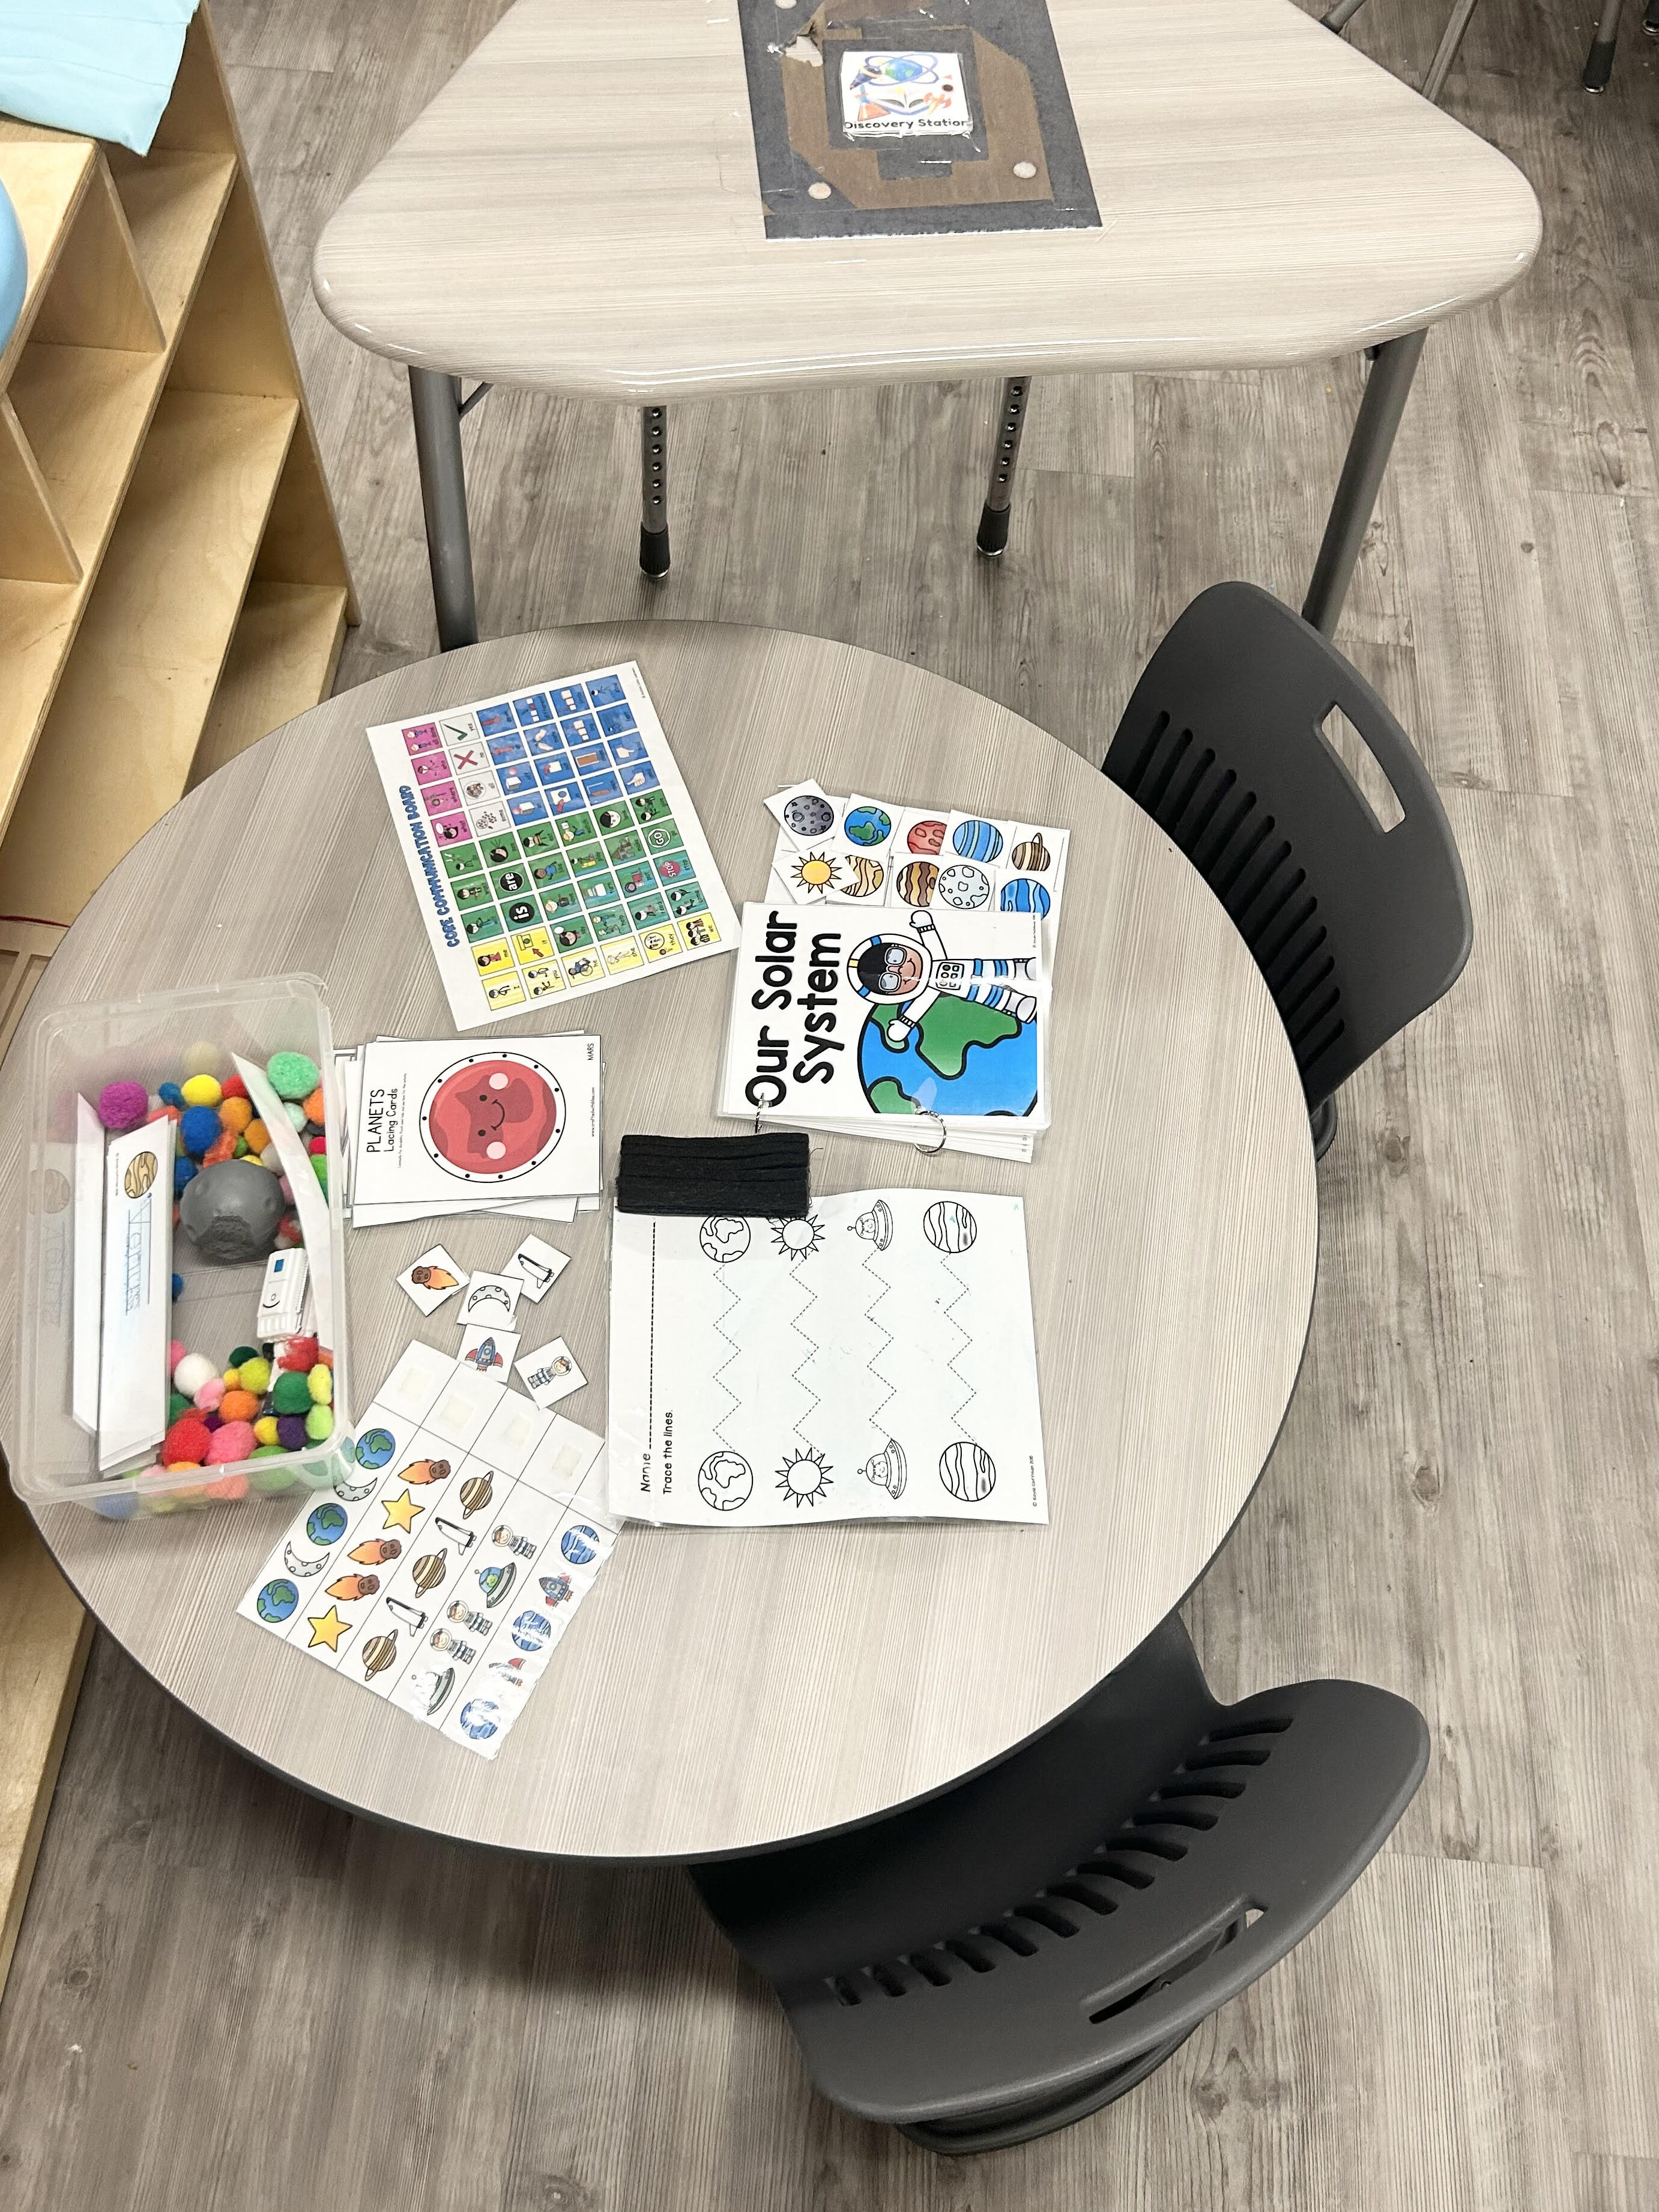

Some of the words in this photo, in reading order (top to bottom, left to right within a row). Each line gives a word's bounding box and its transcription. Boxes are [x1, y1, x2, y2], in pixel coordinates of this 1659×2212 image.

[537, 695, 550, 720] different
[467, 722, 476, 731] yes
[399, 785, 420, 820] BOARD
[449, 787, 458, 802] where
[653, 831, 665, 845] GO
[409, 821, 450, 915] COMMUNICATION
[664, 861, 676, 877] STOP
[681, 859, 690, 871] stop
[504, 872, 518, 890] are
[694, 889, 703, 903] come
[510, 905, 530, 920] is
[656, 901, 665, 914] read
[618, 914, 627, 926] help
[439, 917, 459, 947] CORE
[667, 932, 677, 946] they
[502, 949, 509, 957] me
[752, 910, 797, 1011] Solar
[793, 933, 845, 1084] System
[745, 1026, 789, 1107] Our
[386, 1089, 398, 1116] Cards
[366, 1089, 384, 1152] PLANETS
[384, 1120, 398, 1152] Lacing
[663, 1410, 672, 1436] lines.
[663, 1440, 672, 1458] the
[663, 1463, 672, 1494] Trace
